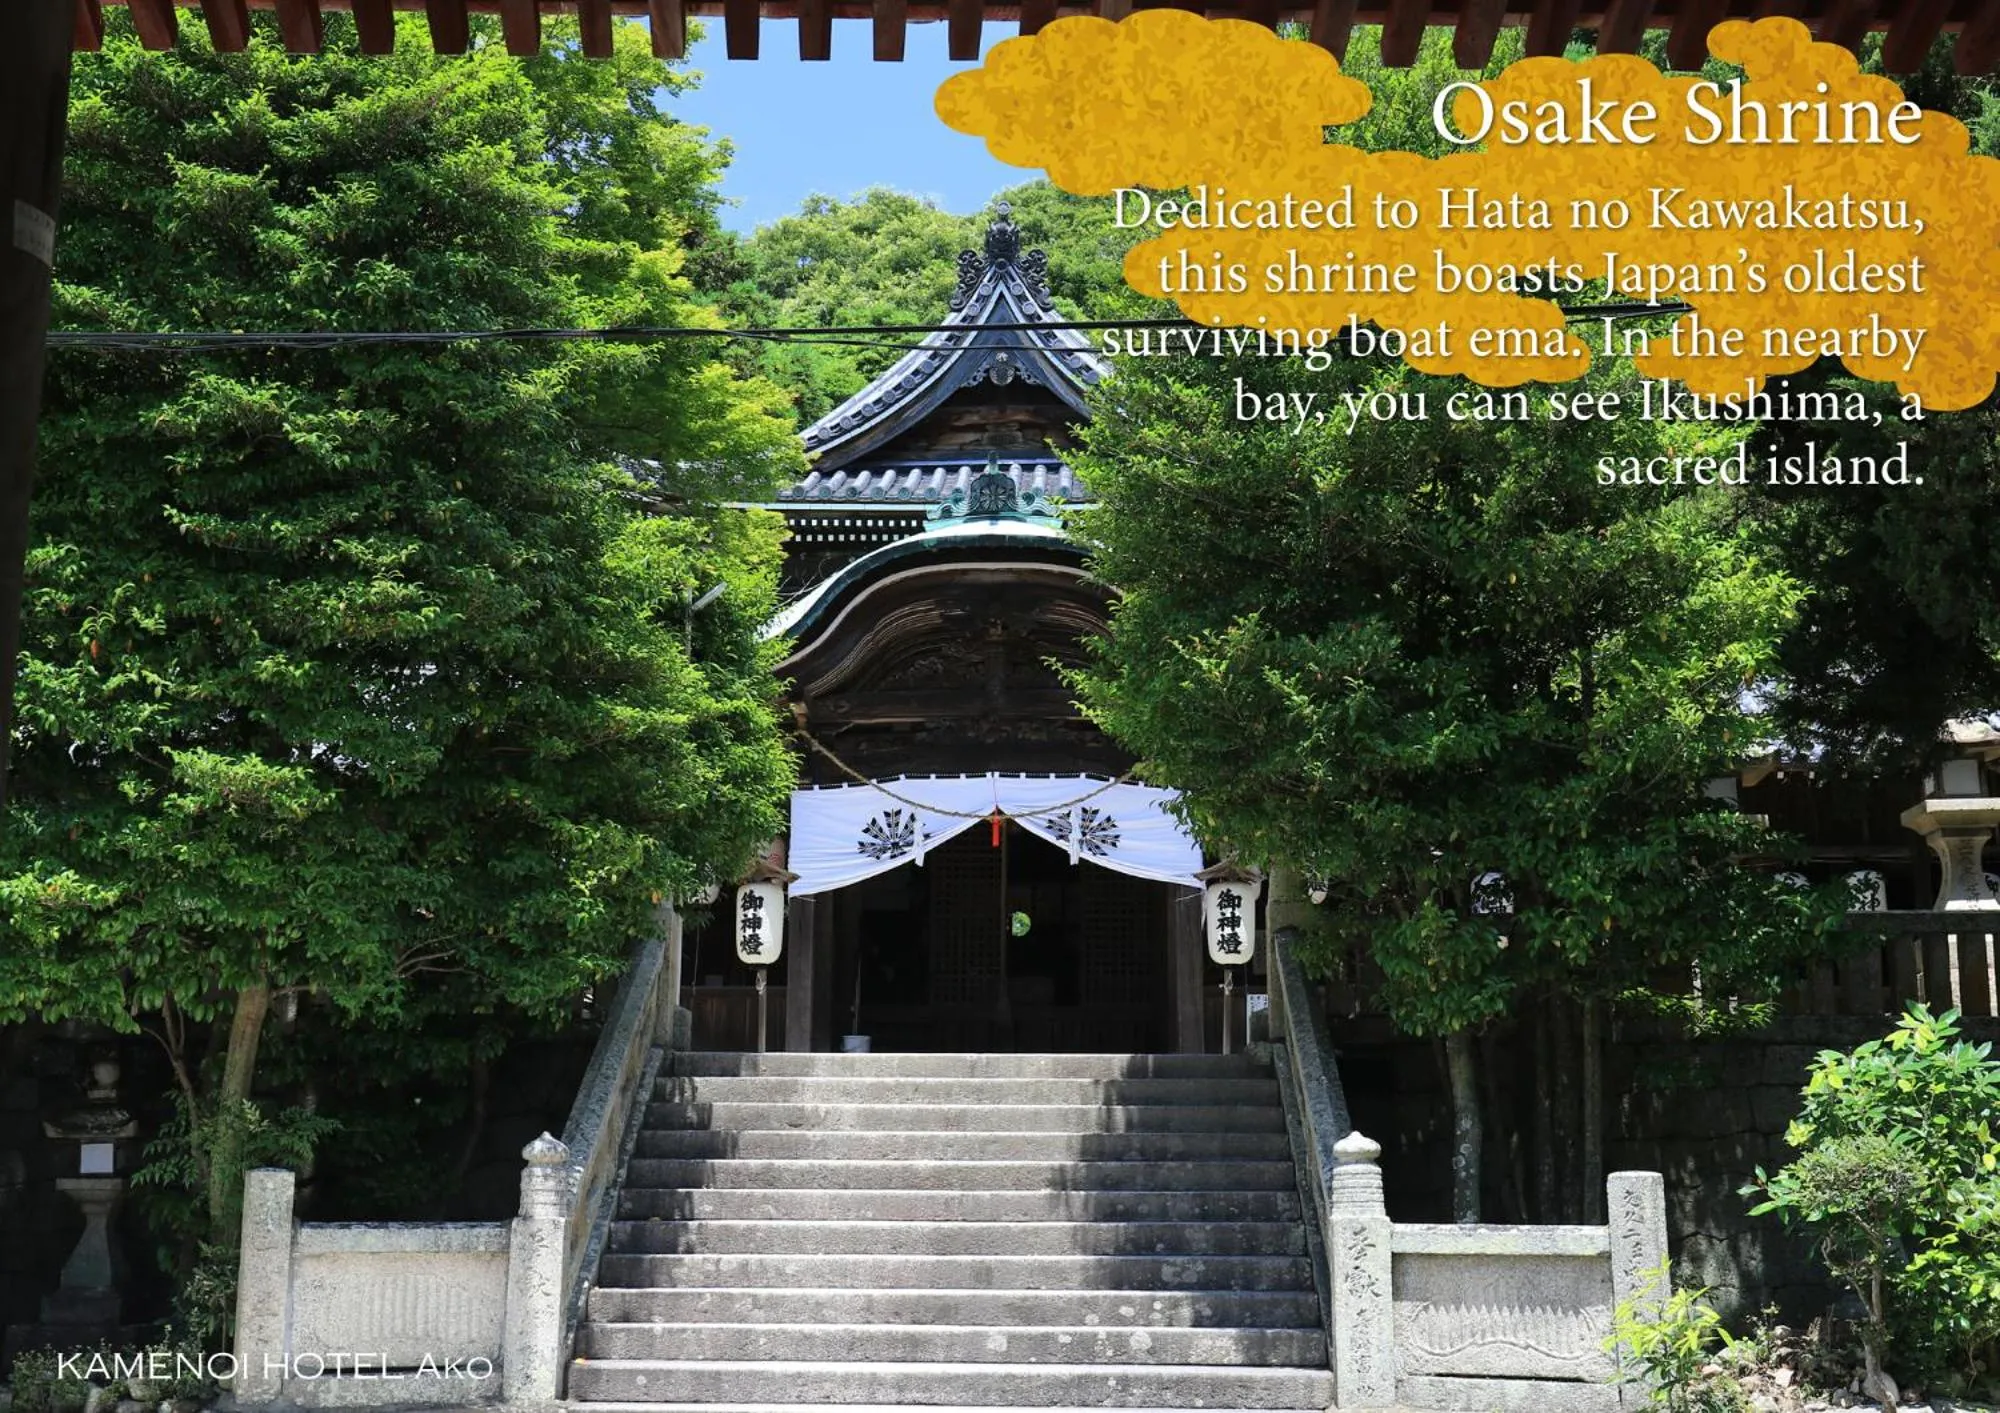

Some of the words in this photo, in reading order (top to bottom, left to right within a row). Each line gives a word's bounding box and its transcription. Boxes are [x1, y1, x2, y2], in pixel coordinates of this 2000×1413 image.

[740, 889, 765, 956] 御神燈
[1216, 888, 1243, 955] 御神燈
